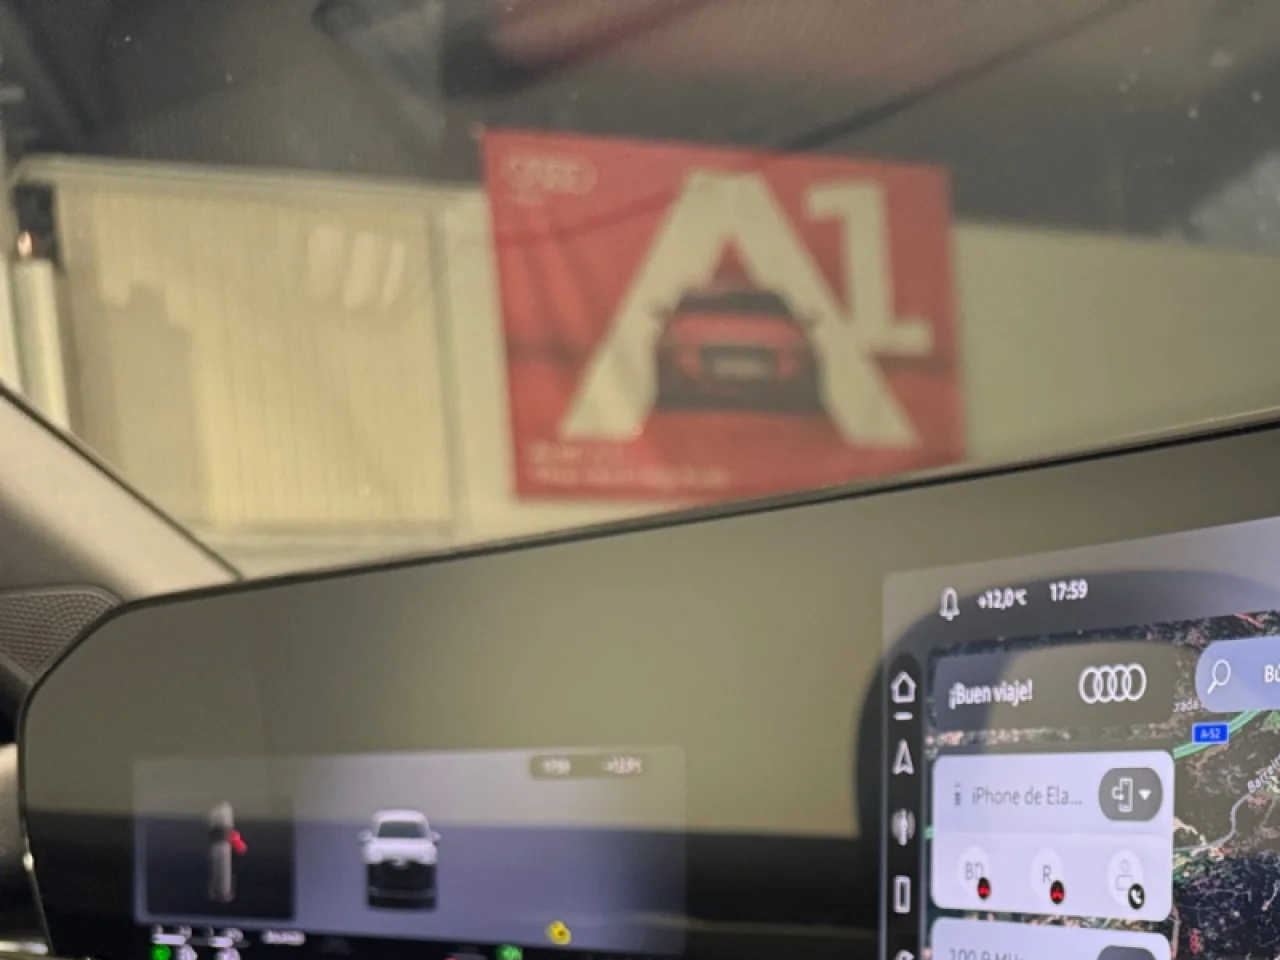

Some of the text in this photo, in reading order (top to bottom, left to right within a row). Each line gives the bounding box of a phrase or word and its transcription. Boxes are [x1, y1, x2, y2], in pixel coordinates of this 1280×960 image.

[1049, 578, 1090, 602] 17:59
[993, 677, 1034, 707] viaje!
[970, 786, 1021, 807] iPhone
[1023, 787, 1043, 807] de
